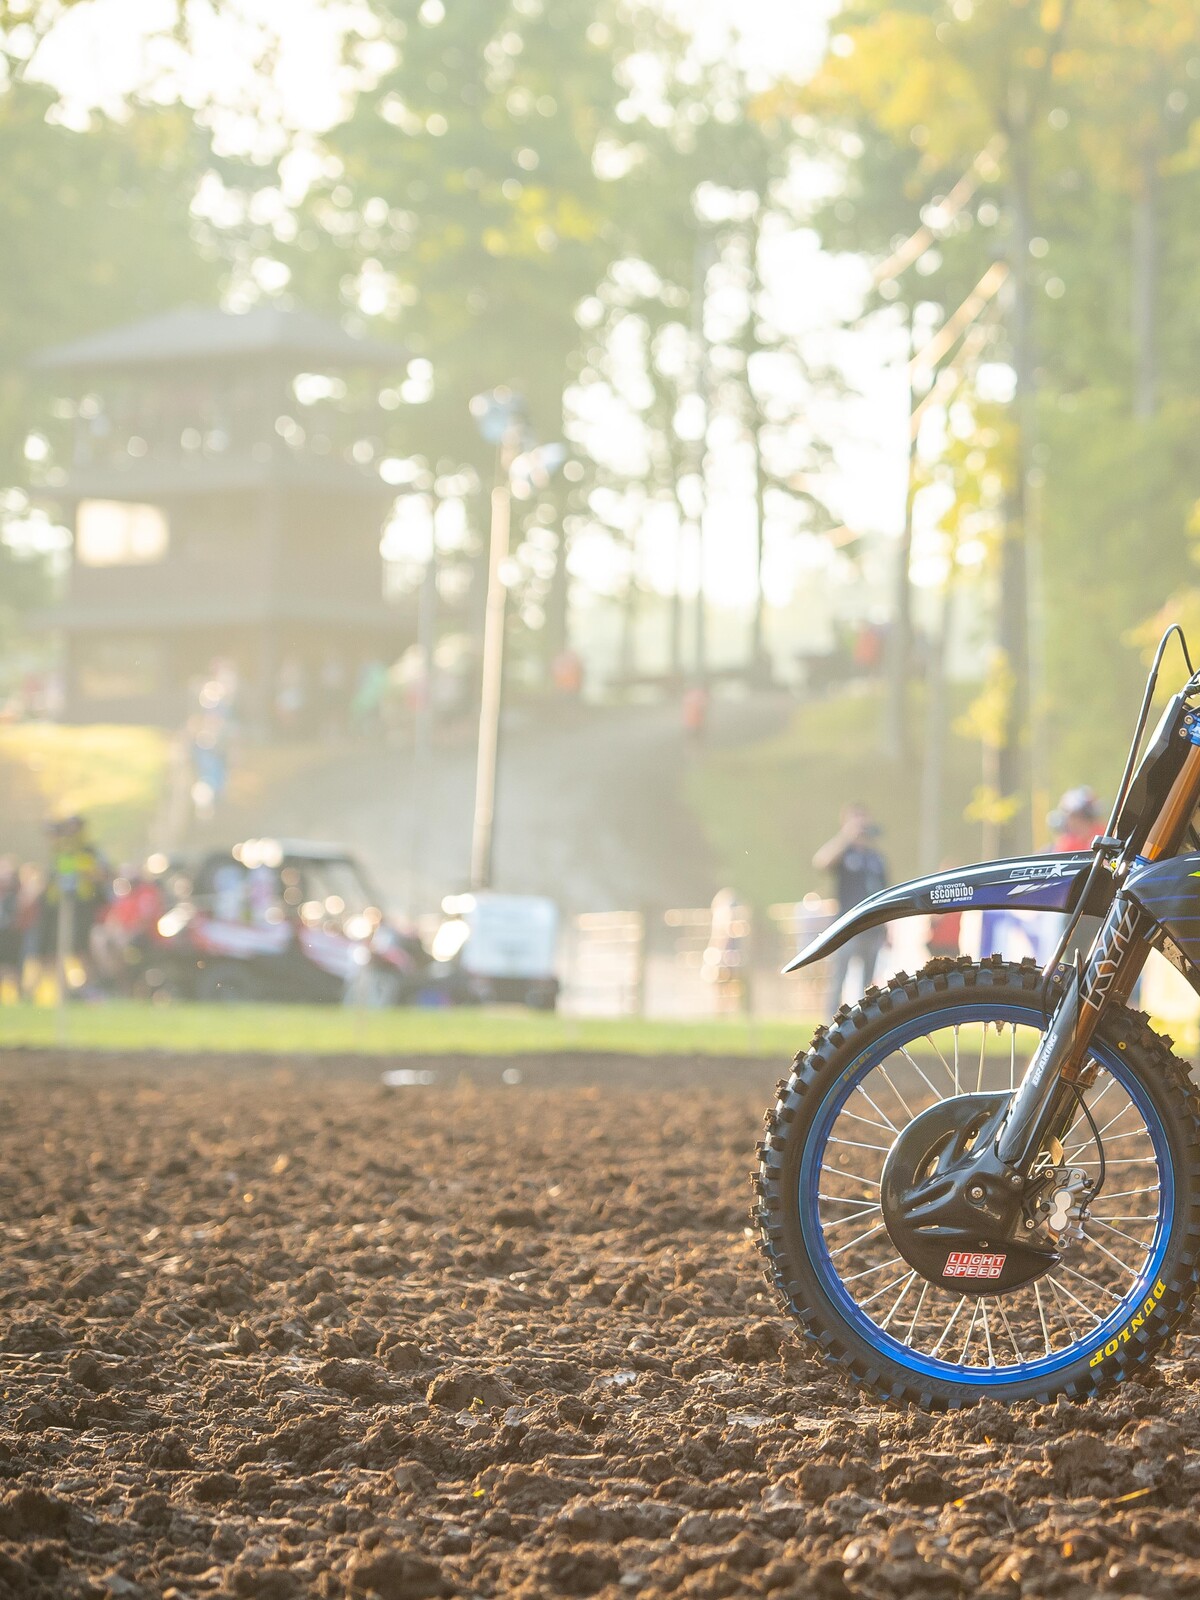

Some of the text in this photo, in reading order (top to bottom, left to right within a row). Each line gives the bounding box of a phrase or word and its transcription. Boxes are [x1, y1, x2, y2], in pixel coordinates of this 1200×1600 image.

[930, 886, 974, 900] ESCONDIDO
[1031, 1031, 1058, 1088] BRAKING
[948, 1253, 1004, 1266] LIGHT
[945, 1265, 1002, 1277] SPEED
[1089, 1278, 1166, 1368] DUNLOP
